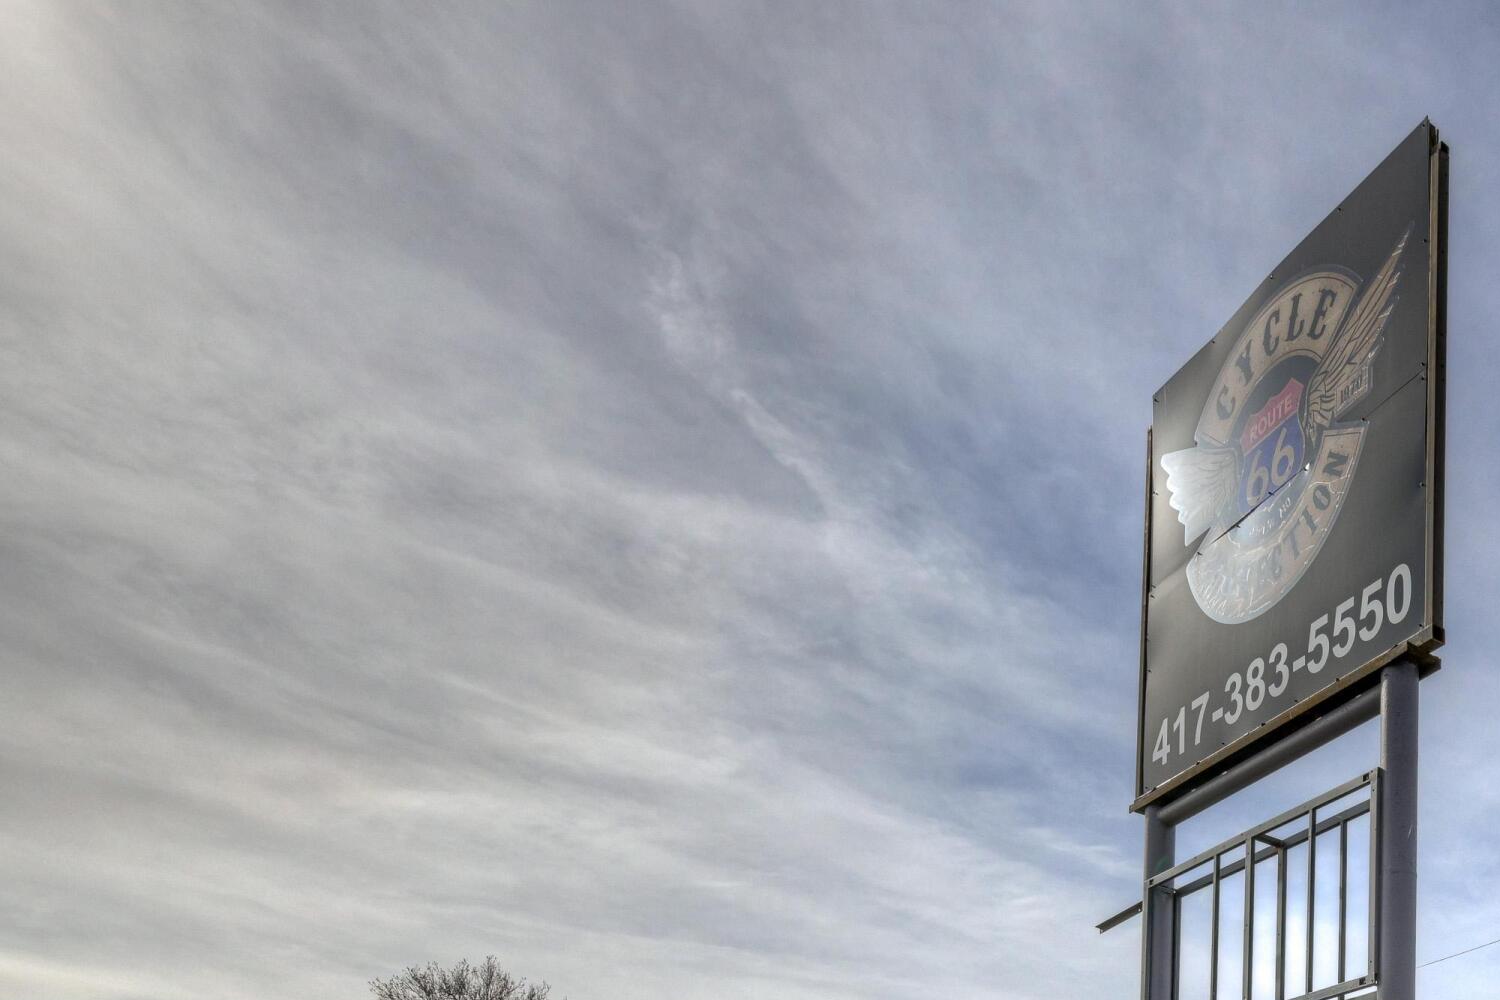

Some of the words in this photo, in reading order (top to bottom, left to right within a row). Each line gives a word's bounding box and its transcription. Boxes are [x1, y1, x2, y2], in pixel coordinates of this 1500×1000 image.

[1216, 288, 1337, 420] CYCLE
[1246, 427, 1295, 505] 66
[1250, 394, 1295, 440] ROUTE
[1152, 563, 1412, 765] 417-383-5550
